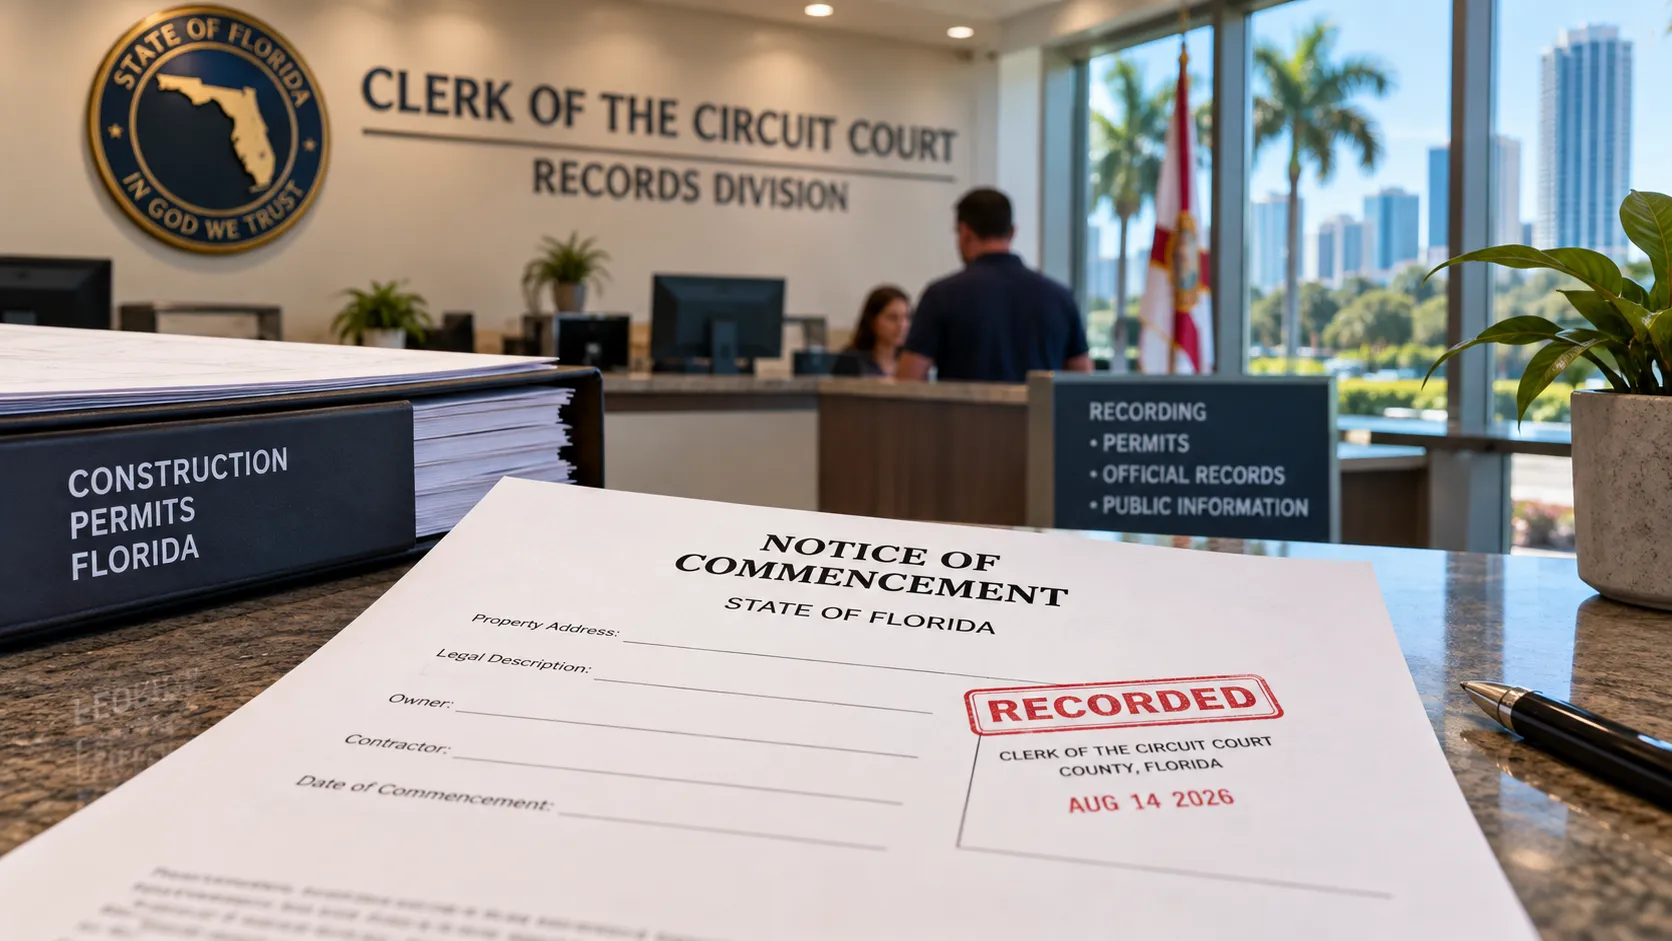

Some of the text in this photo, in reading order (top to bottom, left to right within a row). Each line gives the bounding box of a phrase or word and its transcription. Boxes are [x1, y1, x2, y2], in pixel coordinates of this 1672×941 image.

[113, 18, 310, 108] STATE OF FLORIDA
[362, 67, 958, 162] CLERK OF THE CIRCUIT COURT
[533, 158, 849, 213] RECORDS DIVISION
[122, 172, 304, 240] IN GOD WE TRUST
[1089, 402, 1207, 422] RECORDING
[1103, 433, 1190, 453] PERMITS
[68, 447, 288, 498] CONSTRUCTION
[1103, 465, 1286, 485] OFFICIAL RECORDS
[71, 496, 196, 540] PERMITS
[1103, 496, 1309, 517] PUBLIC INFORMATION
[72, 534, 200, 581] FLORIDA
[760, 534, 1001, 572] NOTICE OF
[675, 553, 1069, 607] COMMENCEMENT
[471, 613, 620, 638] Property Address:
[724, 597, 996, 635] STATE OF FLORIDA
[436, 648, 592, 674] Legal Description:
[388, 693, 453, 709] Owner:
[987, 686, 1257, 723] RECORDED
[344, 734, 451, 755] Contractor:
[999, 736, 1273, 761] CLERK OF THE CIRCUIT COURT
[1059, 758, 1224, 778] COUNTY, FLORIDA
[296, 775, 555, 812] Date of Commencement:
[1068, 788, 1235, 814] AUG 14 2026
